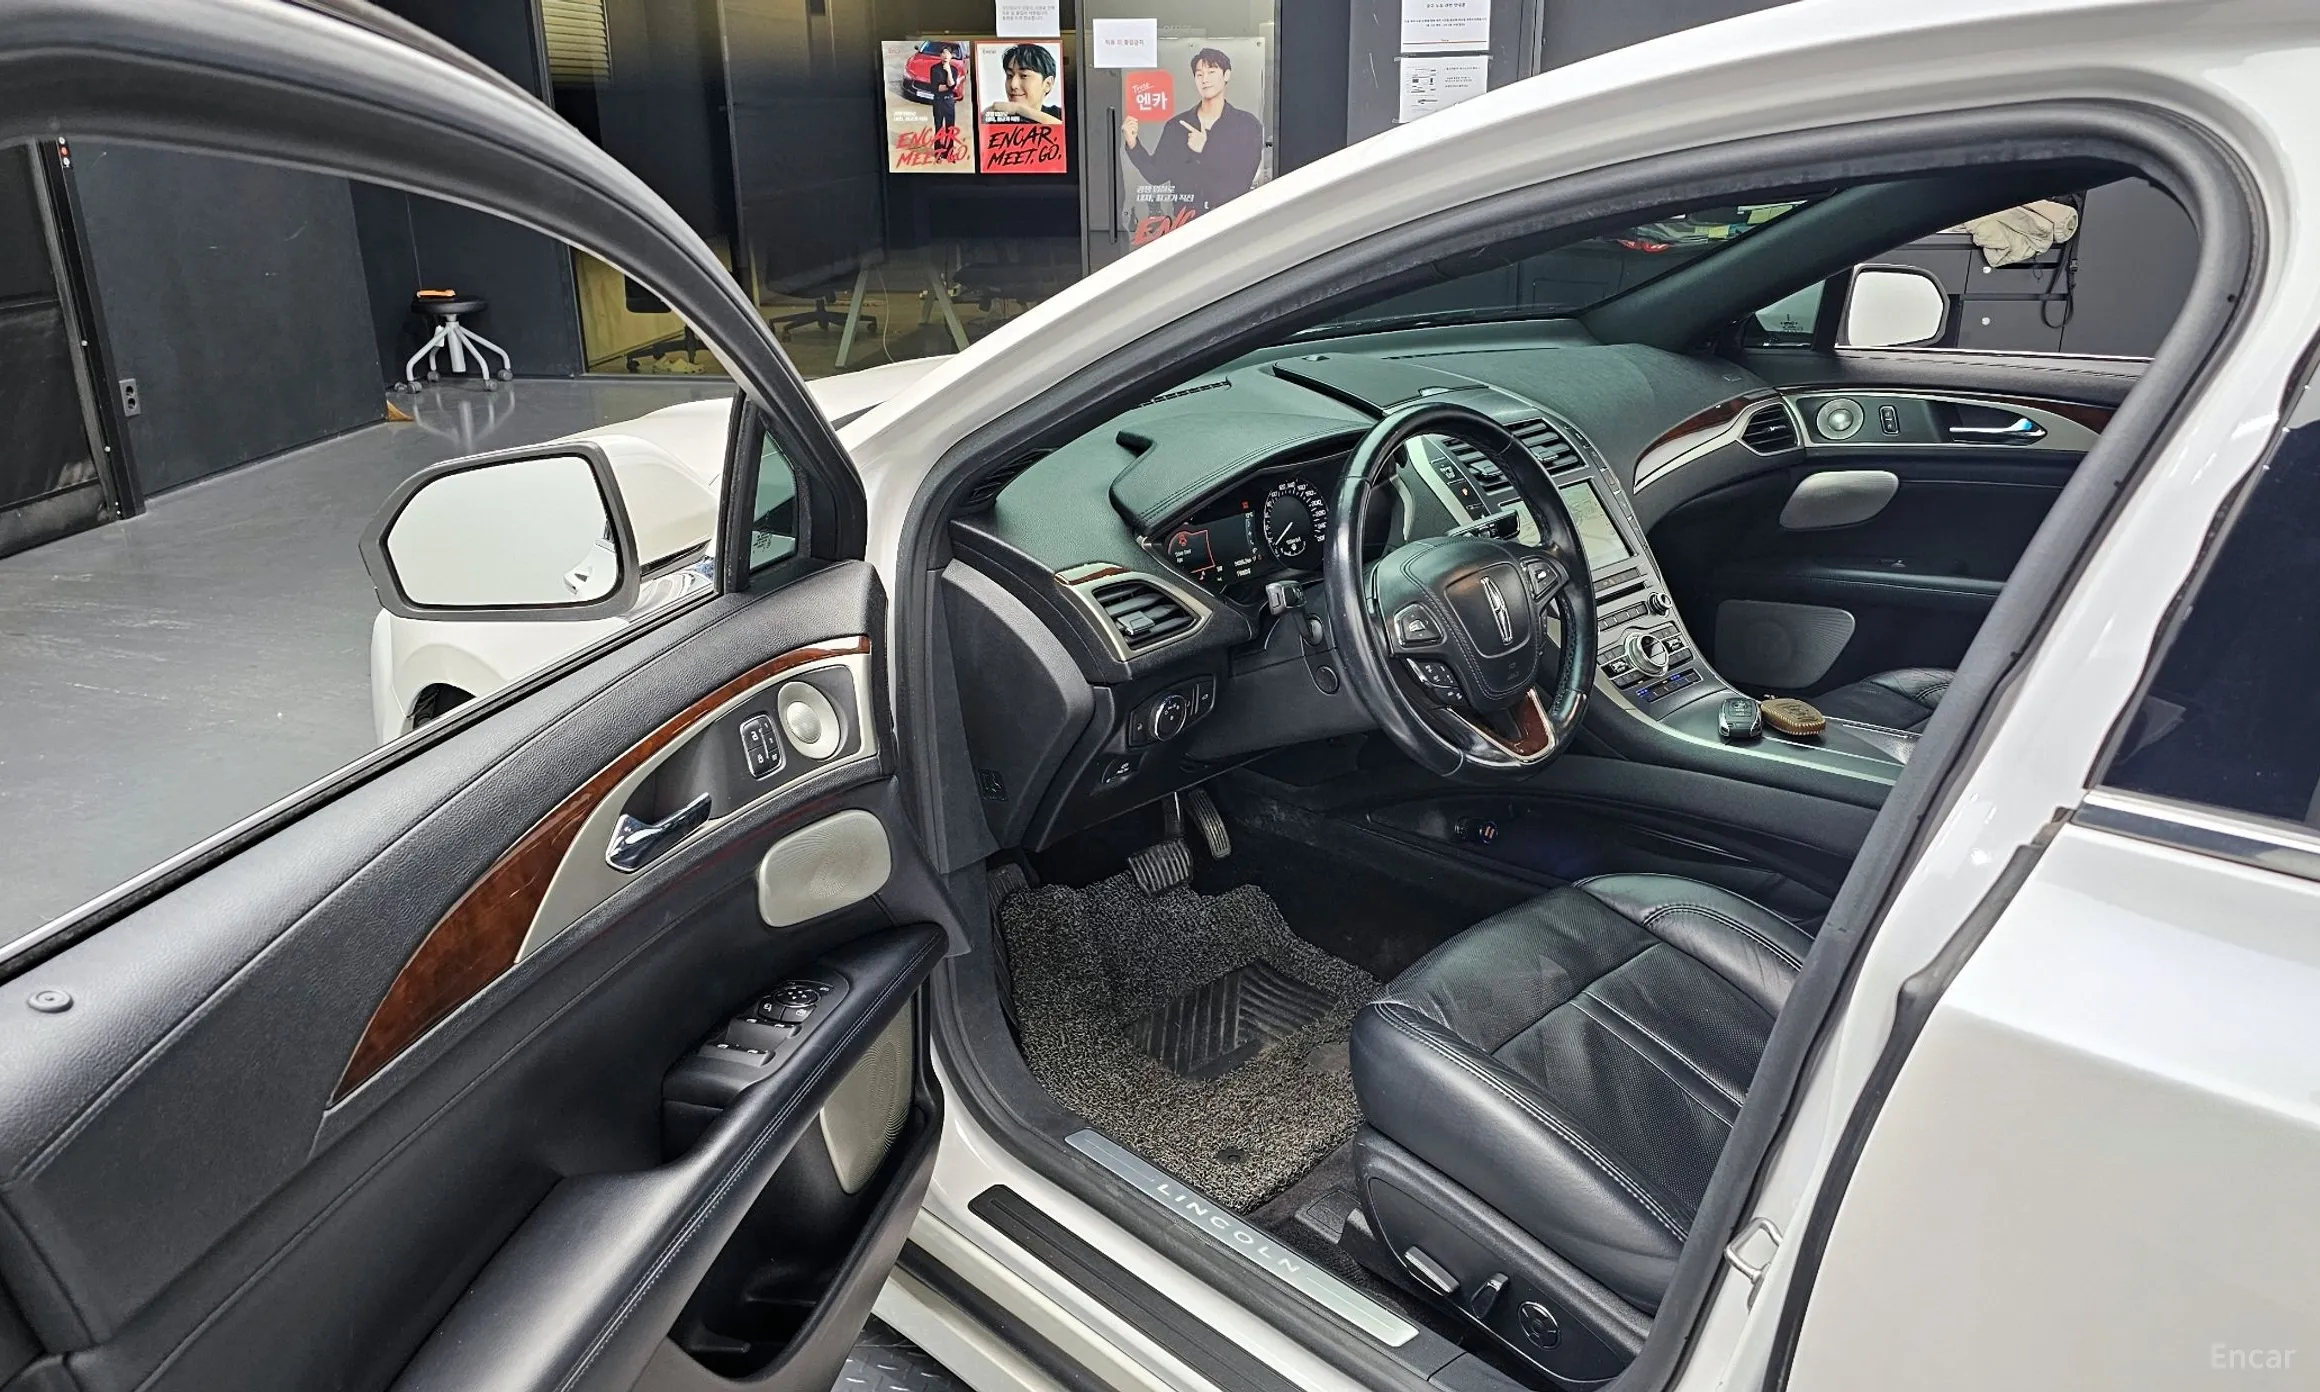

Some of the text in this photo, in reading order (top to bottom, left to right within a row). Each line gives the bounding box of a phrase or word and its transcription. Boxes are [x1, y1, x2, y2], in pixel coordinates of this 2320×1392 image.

[1136, 91, 1168, 111] 엔카
[987, 126, 1057, 149] ENCAR.
[987, 144, 1061, 169] MEET. GO.
[1156, 1183, 1300, 1273] LINCOLN
